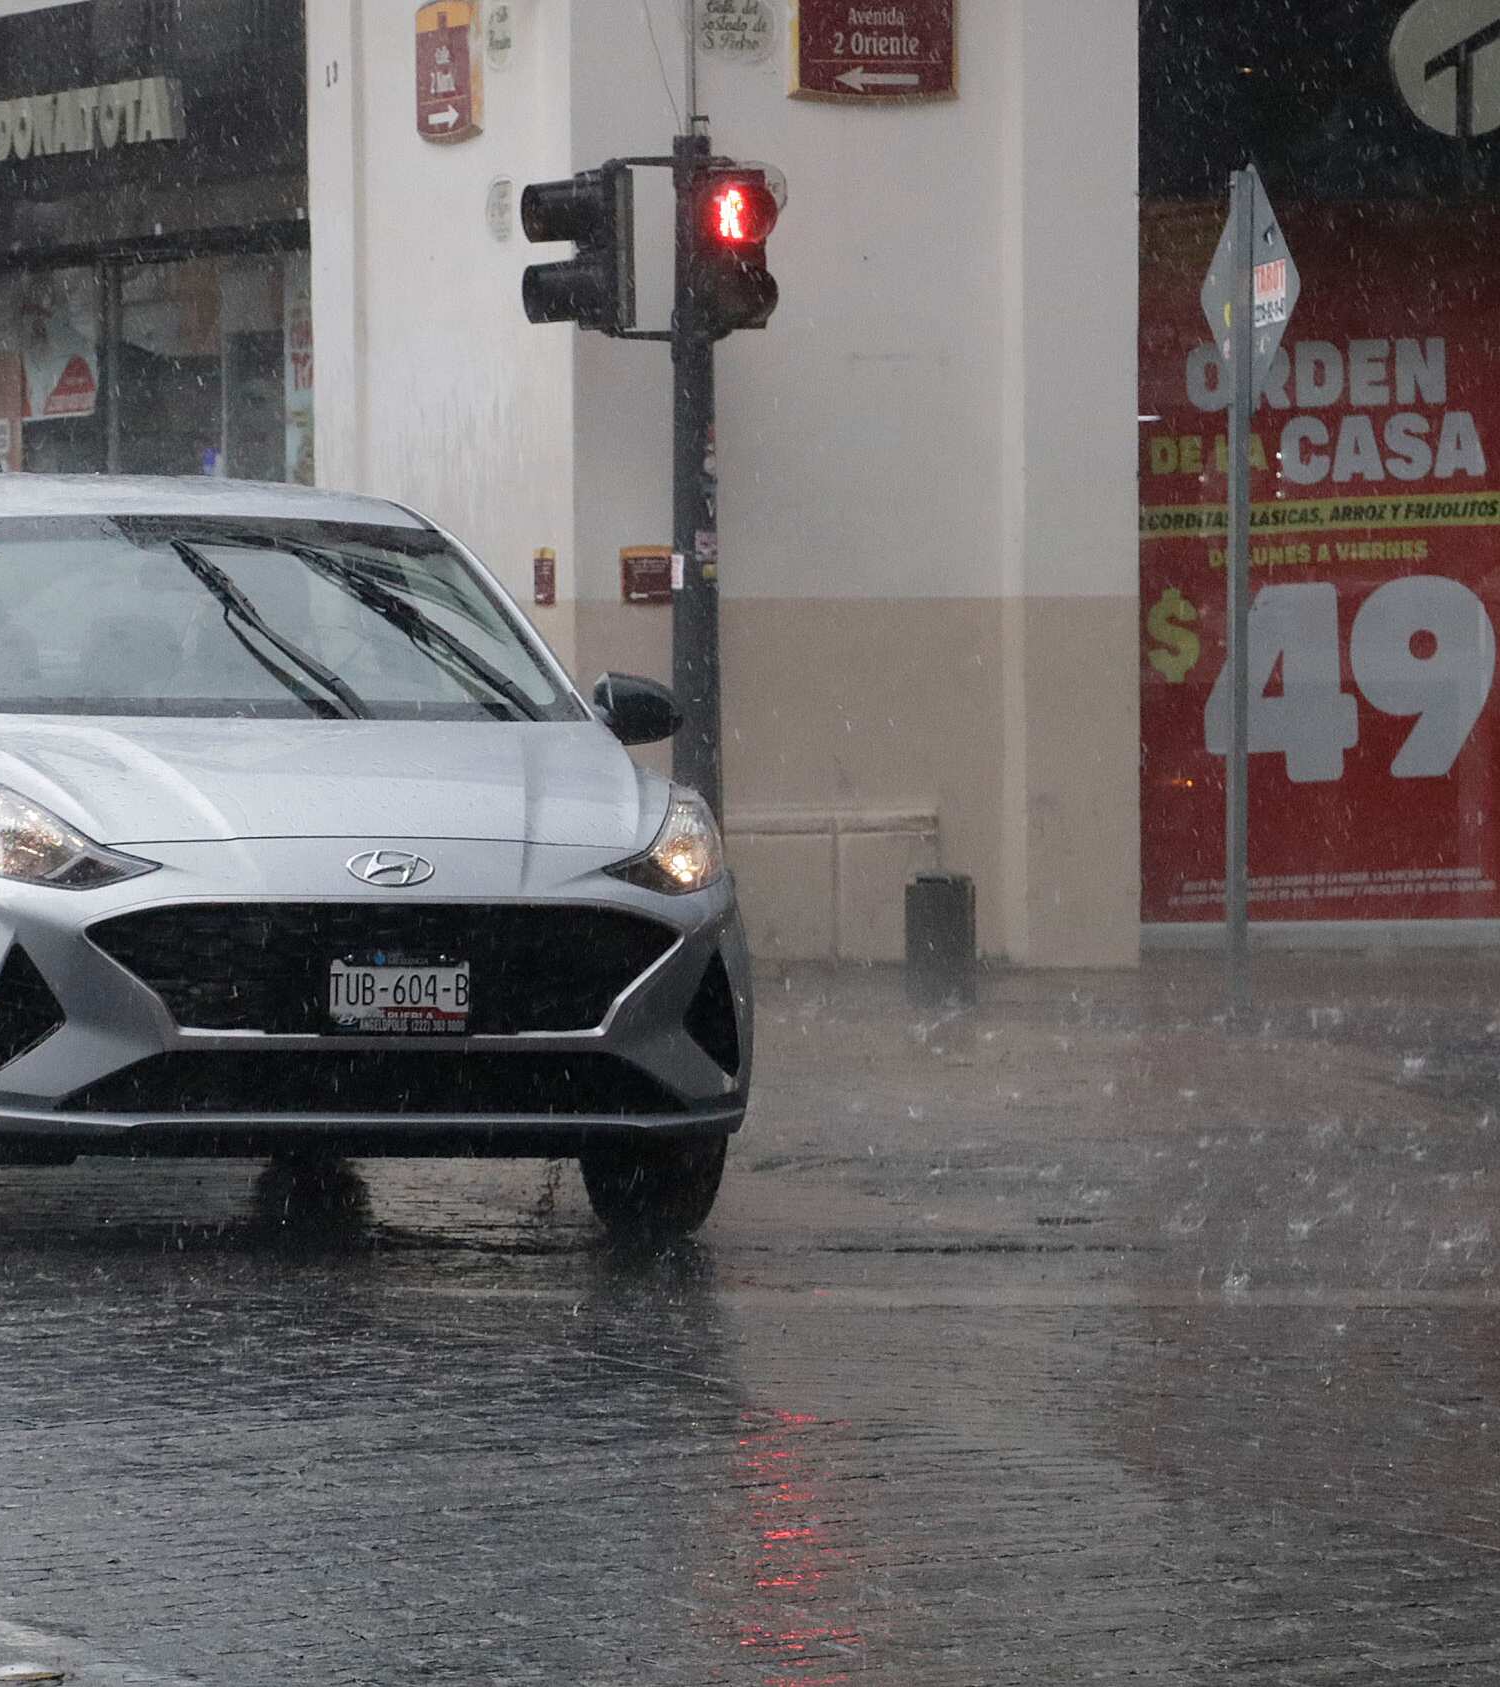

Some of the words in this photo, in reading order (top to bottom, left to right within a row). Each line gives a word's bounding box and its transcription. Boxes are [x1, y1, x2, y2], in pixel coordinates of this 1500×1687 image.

[847, 7, 906, 26] Avenida
[833, 32, 844, 55] 2
[851, 31, 920, 55] Oriente
[1186, 337, 1447, 412] ORDEN
[1151, 434, 1203, 476] DE
[1280, 411, 1487, 485] CASA
[1330, 504, 1387, 521] ARROZ
[1391, 503, 1403, 520] Y
[1404, 499, 1499, 520] FRIJOLITOS
[1251, 542, 1311, 566] UNES
[1317, 543, 1331, 562] A
[1336, 539, 1428, 561] VIERNES
[1148, 586, 1201, 684] $
[1203, 574, 1496, 783] 49
[331, 973, 468, 1006] TUB-604-B
